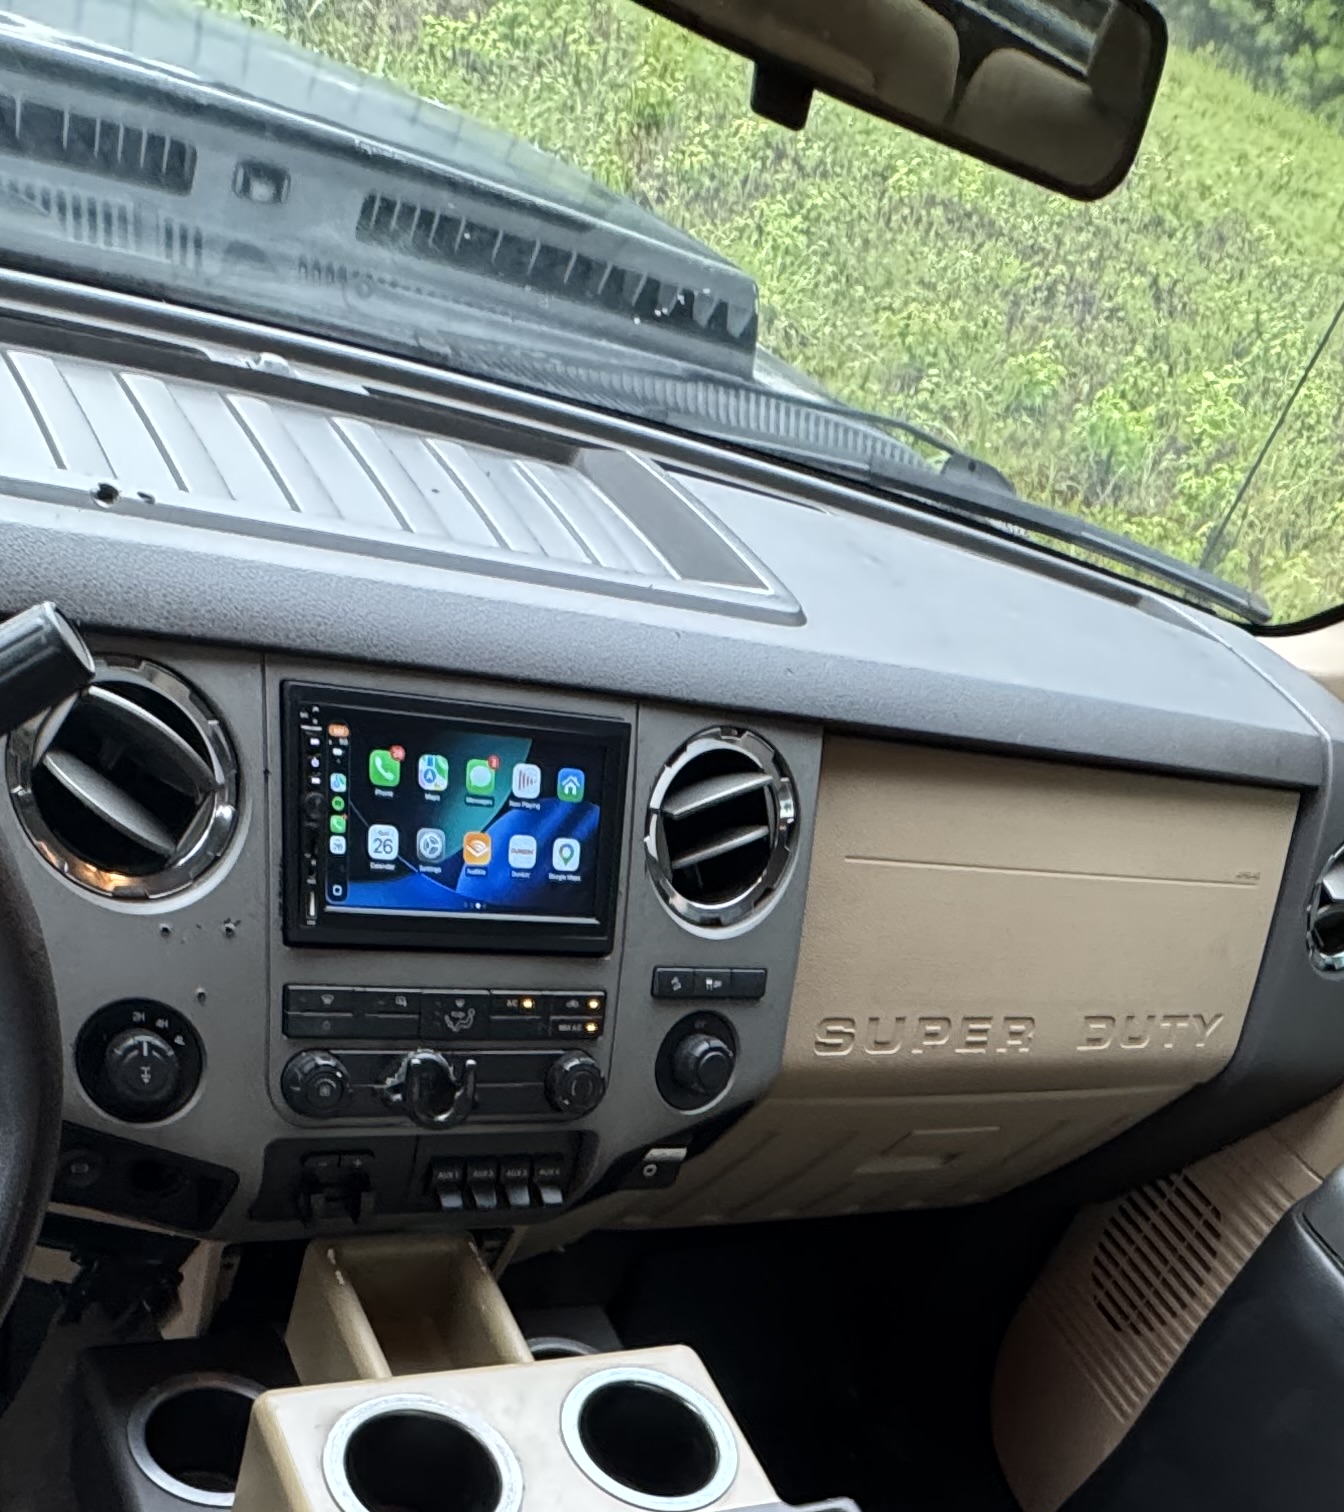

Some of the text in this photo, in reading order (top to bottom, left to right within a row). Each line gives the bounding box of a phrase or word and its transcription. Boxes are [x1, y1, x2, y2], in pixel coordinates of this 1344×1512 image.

[373, 838, 394, 854] 26
[813, 1012, 1225, 1056] SUPER DUTY
